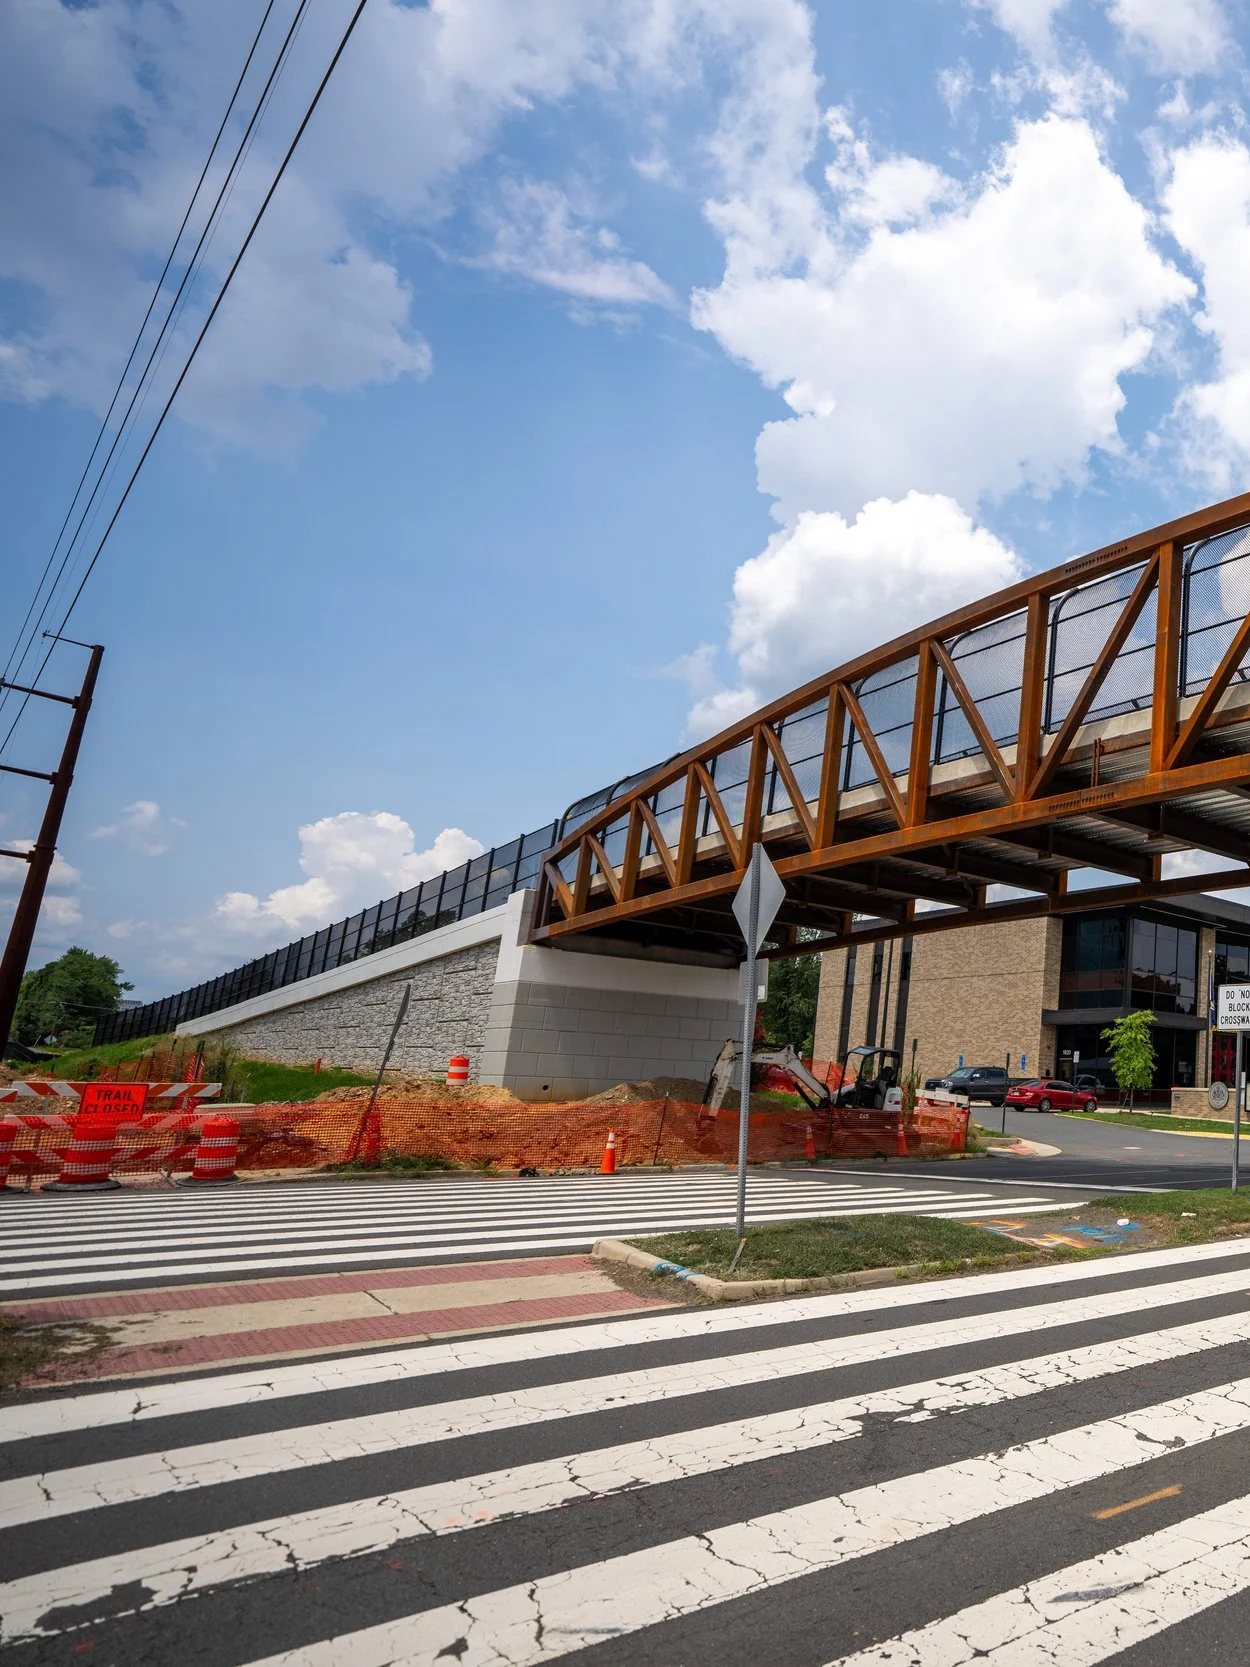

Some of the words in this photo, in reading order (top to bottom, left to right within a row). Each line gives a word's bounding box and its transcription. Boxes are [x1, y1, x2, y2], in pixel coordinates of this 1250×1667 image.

[1226, 991, 1235, 999] DO
[1228, 1003, 1250, 1011] BLOCK
[96, 1090, 134, 1101] TRAIL
[84, 1104, 139, 1114] CLOSED
